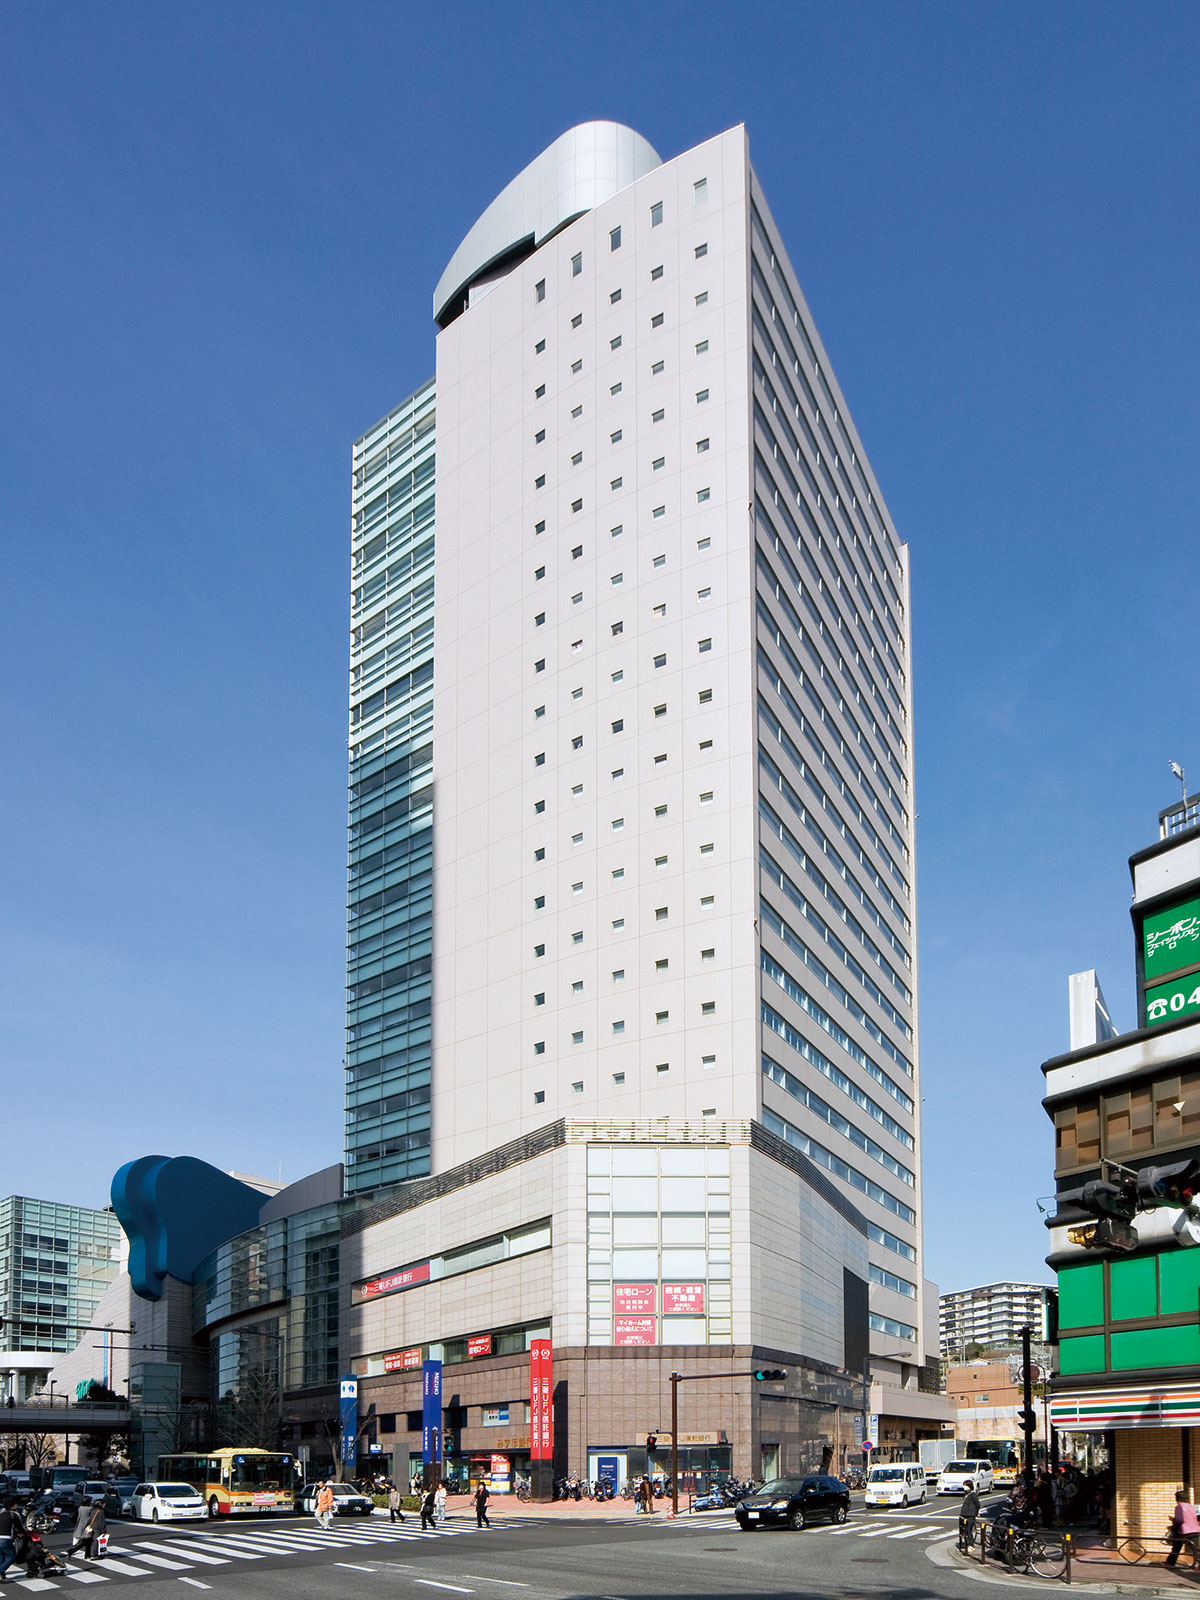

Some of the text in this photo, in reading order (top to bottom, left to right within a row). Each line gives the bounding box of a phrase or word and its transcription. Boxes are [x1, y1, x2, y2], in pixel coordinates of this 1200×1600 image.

[1147, 927, 1199, 952] フェイシャリスト
[1170, 986, 1200, 1012] 04
[374, 1272, 413, 1292] 三菱UFJ信託銀行
[616, 1288, 653, 1296] 住宅ローン
[671, 1294, 696, 1302] 不動産
[657, 1434, 711, 1443] 三菱J信託銀行
